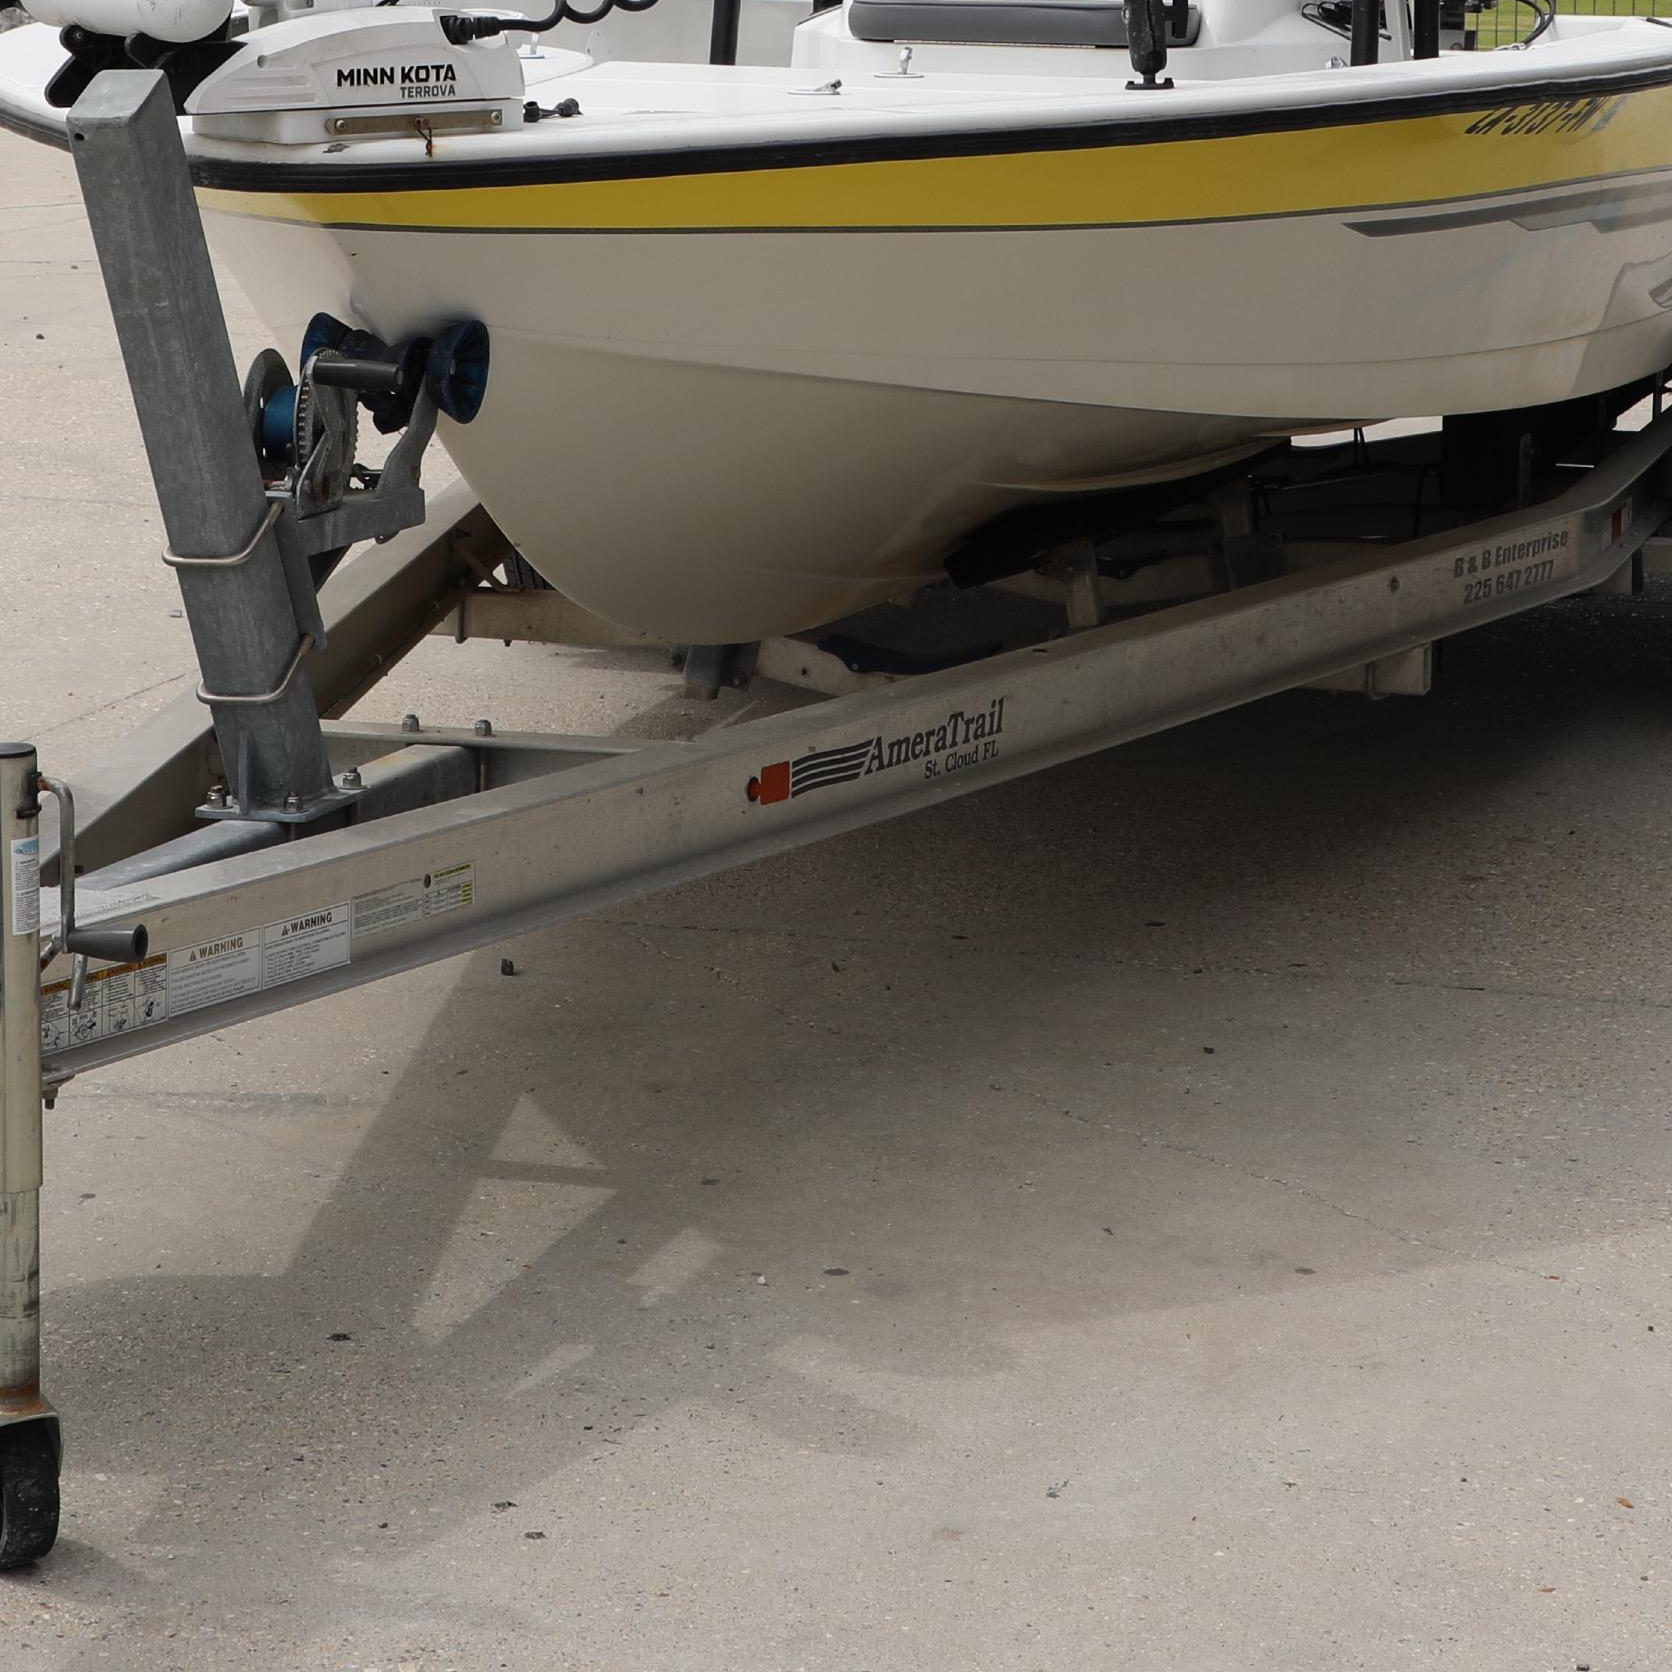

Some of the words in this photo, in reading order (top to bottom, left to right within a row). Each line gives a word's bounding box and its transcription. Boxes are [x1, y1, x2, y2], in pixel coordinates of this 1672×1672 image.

[336, 67, 395, 87] MINN
[400, 64, 457, 84] KOTA
[400, 84, 456, 99] TERROVA
[1454, 557, 1465, 578] B
[1467, 555, 1478, 574] &
[1481, 550, 1492, 570] B
[1495, 530, 1569, 566] Enterprise
[1464, 578, 1492, 605] 225
[1495, 568, 1523, 594] 647
[1524, 559, 1555, 585] 2777
[864, 696, 1007, 775] AmeraTrail
[924, 760, 941, 779] St.
[945, 749, 979, 774] Cloud
[982, 739, 1000, 761] FL
[291, 911, 333, 932] WARNING
[199, 936, 244, 959] WARNING
